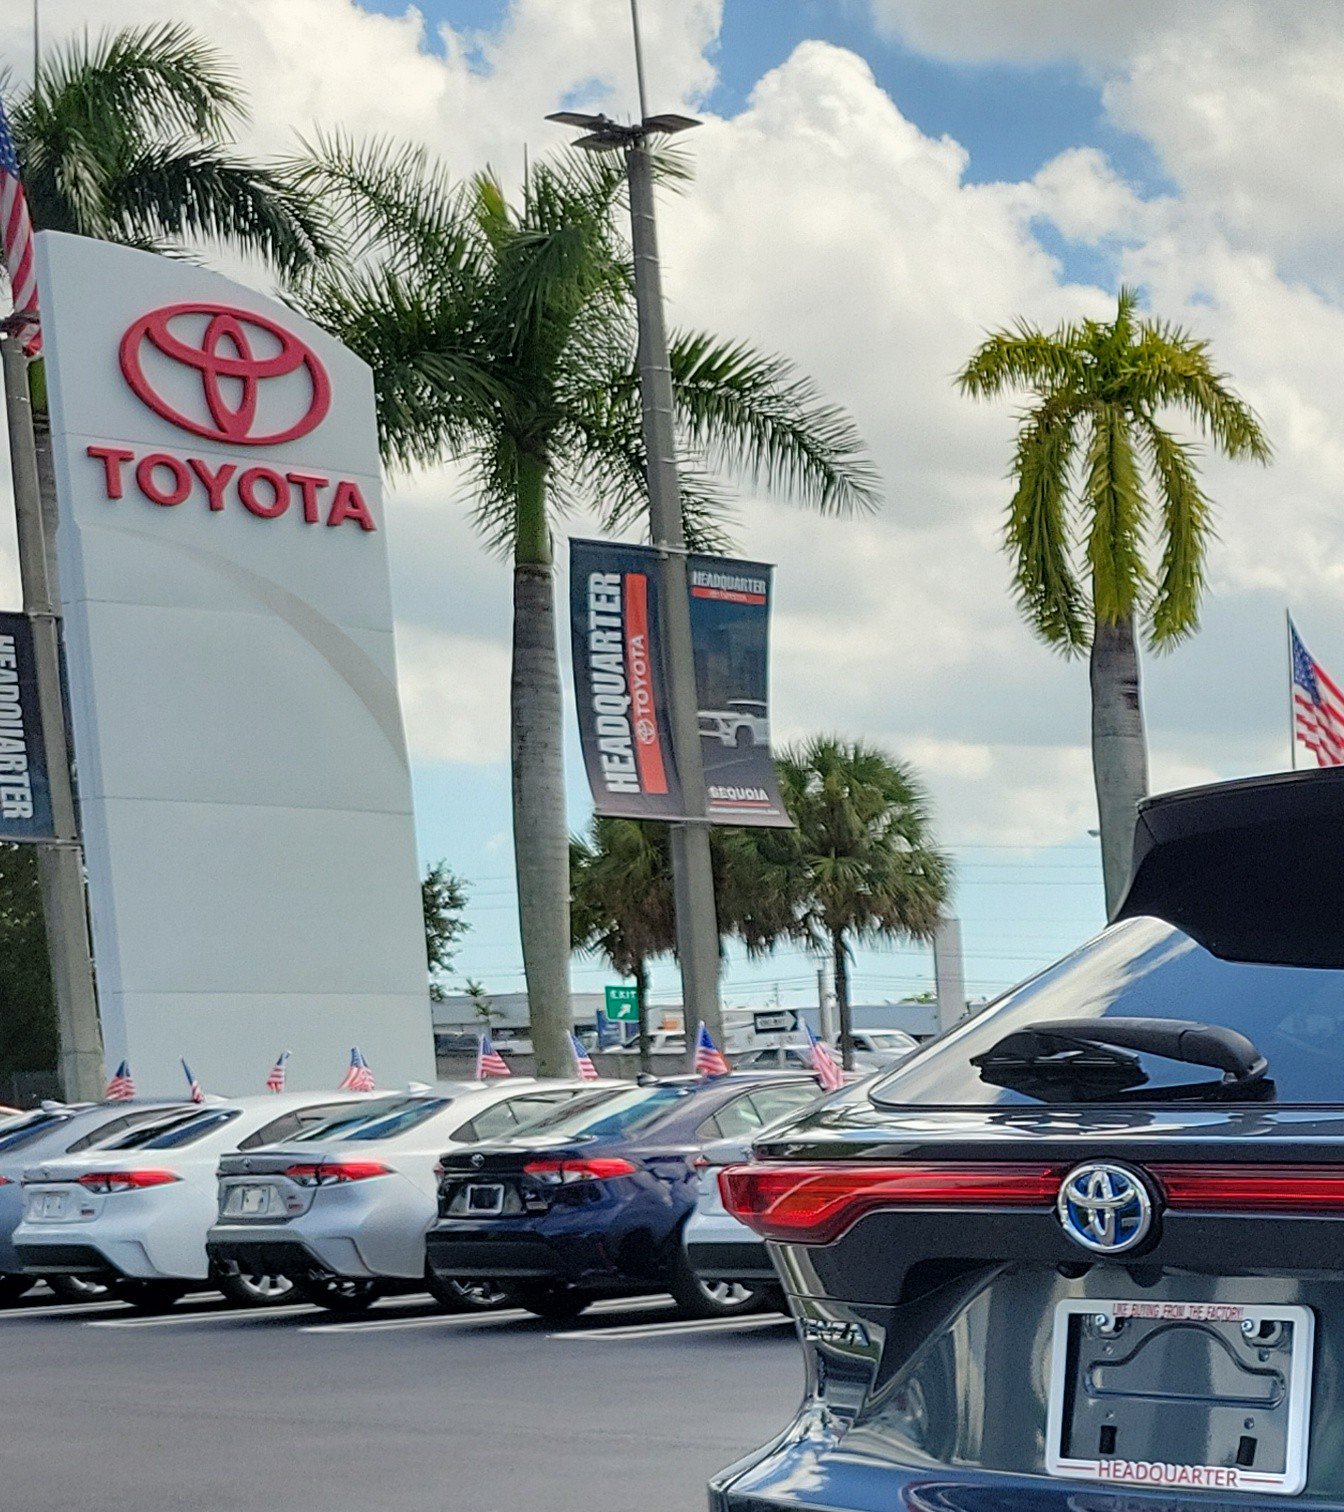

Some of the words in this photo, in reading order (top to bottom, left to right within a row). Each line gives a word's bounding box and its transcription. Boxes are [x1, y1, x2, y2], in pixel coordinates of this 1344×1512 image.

[86, 445, 378, 532] TOYOTA
[692, 571, 767, 594] HEADQUARTER
[588, 572, 641, 794] HEADQUARTER
[629, 634, 655, 718] TOYOTA
[708, 785, 769, 801] SEQUOIA
[1098, 1461, 1239, 1487] HEADQUARTER
